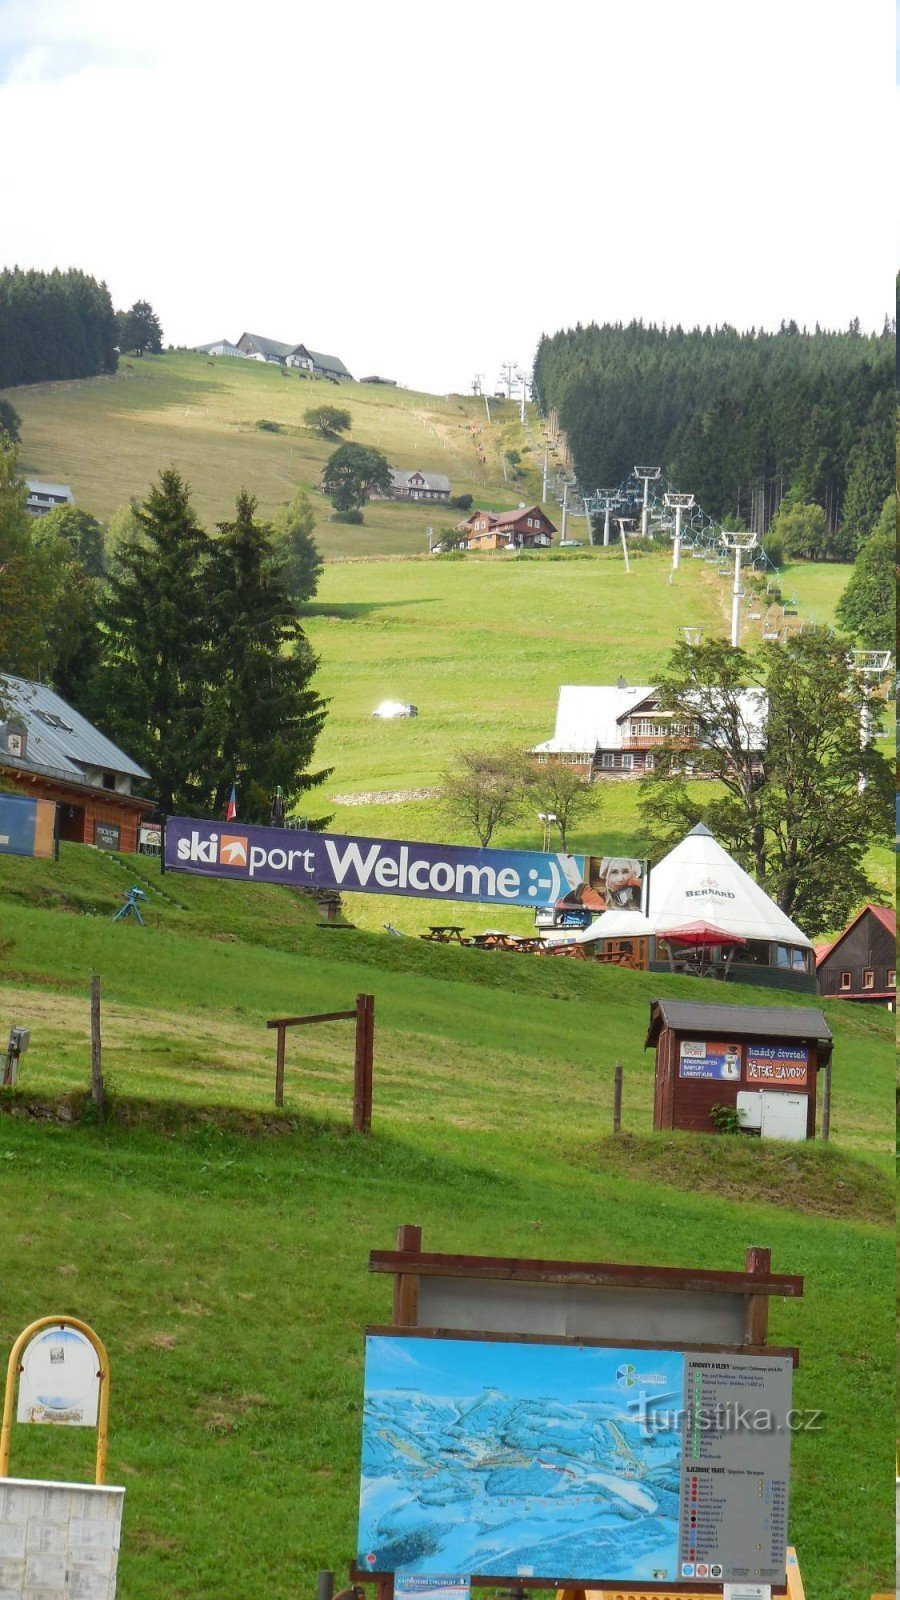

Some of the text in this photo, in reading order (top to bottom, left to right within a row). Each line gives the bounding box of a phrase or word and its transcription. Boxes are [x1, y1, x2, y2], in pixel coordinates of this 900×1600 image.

[325, 840, 520, 898] Welcome
[685, 888, 736, 899] BERNARD
[748, 1047, 806, 1059] každý čtvrtek
[748, 1060, 806, 1079] DĚTSKÉ ZÁVODY
